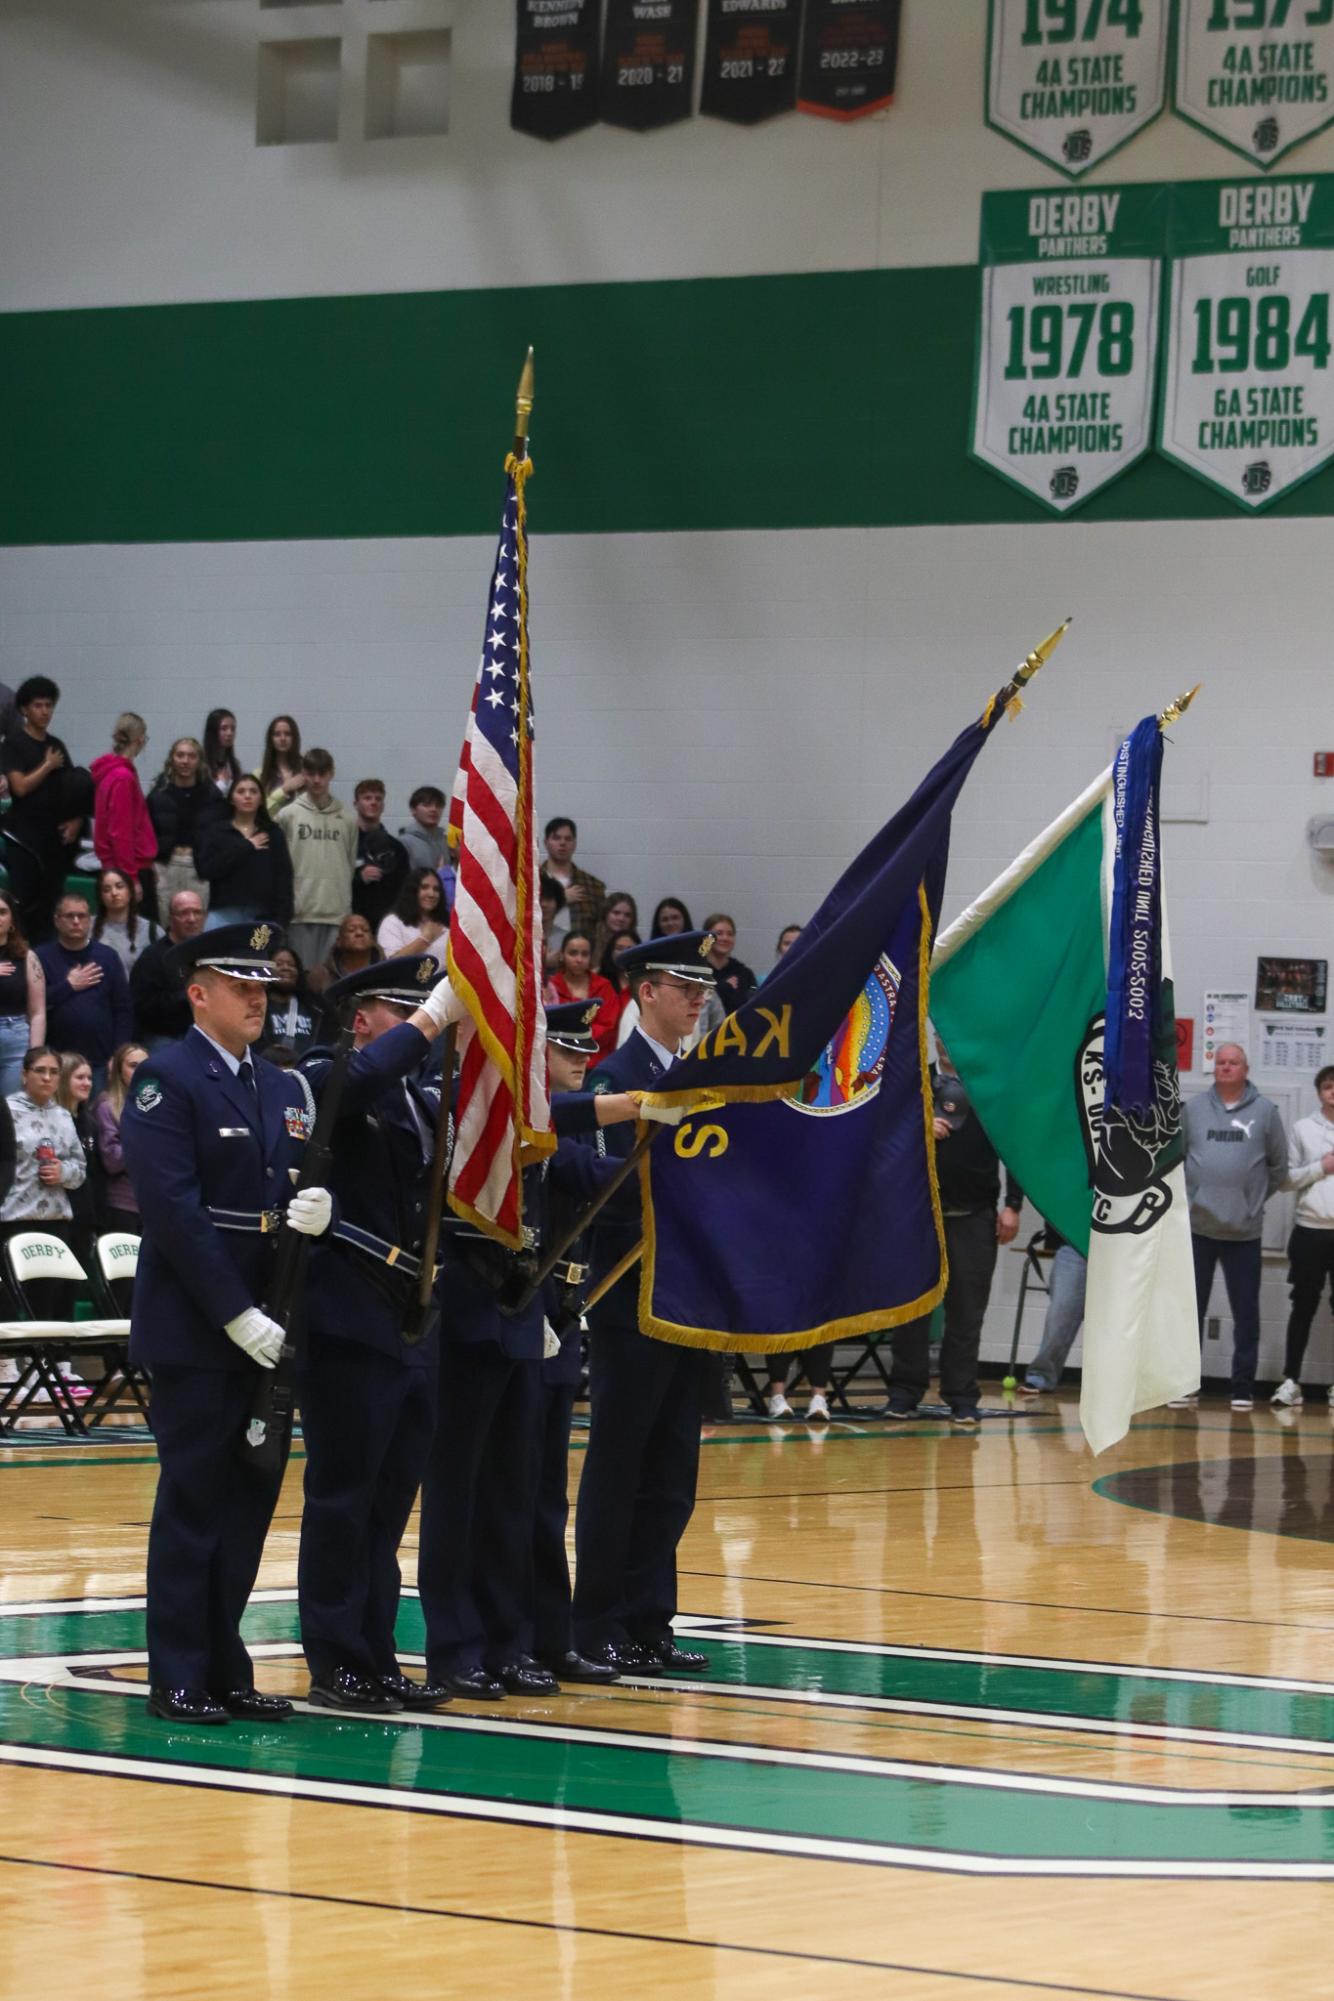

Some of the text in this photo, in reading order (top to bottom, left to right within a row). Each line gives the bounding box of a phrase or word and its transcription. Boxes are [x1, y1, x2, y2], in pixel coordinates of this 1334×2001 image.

[1036, 54, 1123, 88] 4A STATE
[1223, 42, 1314, 74] 4A STATE
[1020, 85, 1136, 120] CHAMPIONS
[1208, 74, 1327, 107] CHAMPIONS
[1029, 193, 1120, 236] DERBY
[1219, 183, 1315, 227] DERBY
[1039, 235, 1107, 257] PANTHERS
[1229, 226, 1300, 248] PANTHERS
[1032, 274, 1110, 296] WRESTLING
[1246, 266, 1281, 287] GOLF
[1004, 302, 1135, 380] 1978
[1192, 293, 1331, 375] 1984
[1023, 393, 1111, 422] 4A STATE
[1214, 386, 1304, 418] 6A STATE
[1008, 424, 1123, 455] CHAMPIONS
[1198, 417, 1318, 451] CHAMPIONS
[1116, 741, 1131, 828] DISTINGUISHED
[298, 824, 340, 841] Duke
[21, 1244, 66, 1260] DERBY
[109, 1244, 140, 1260] DERB
